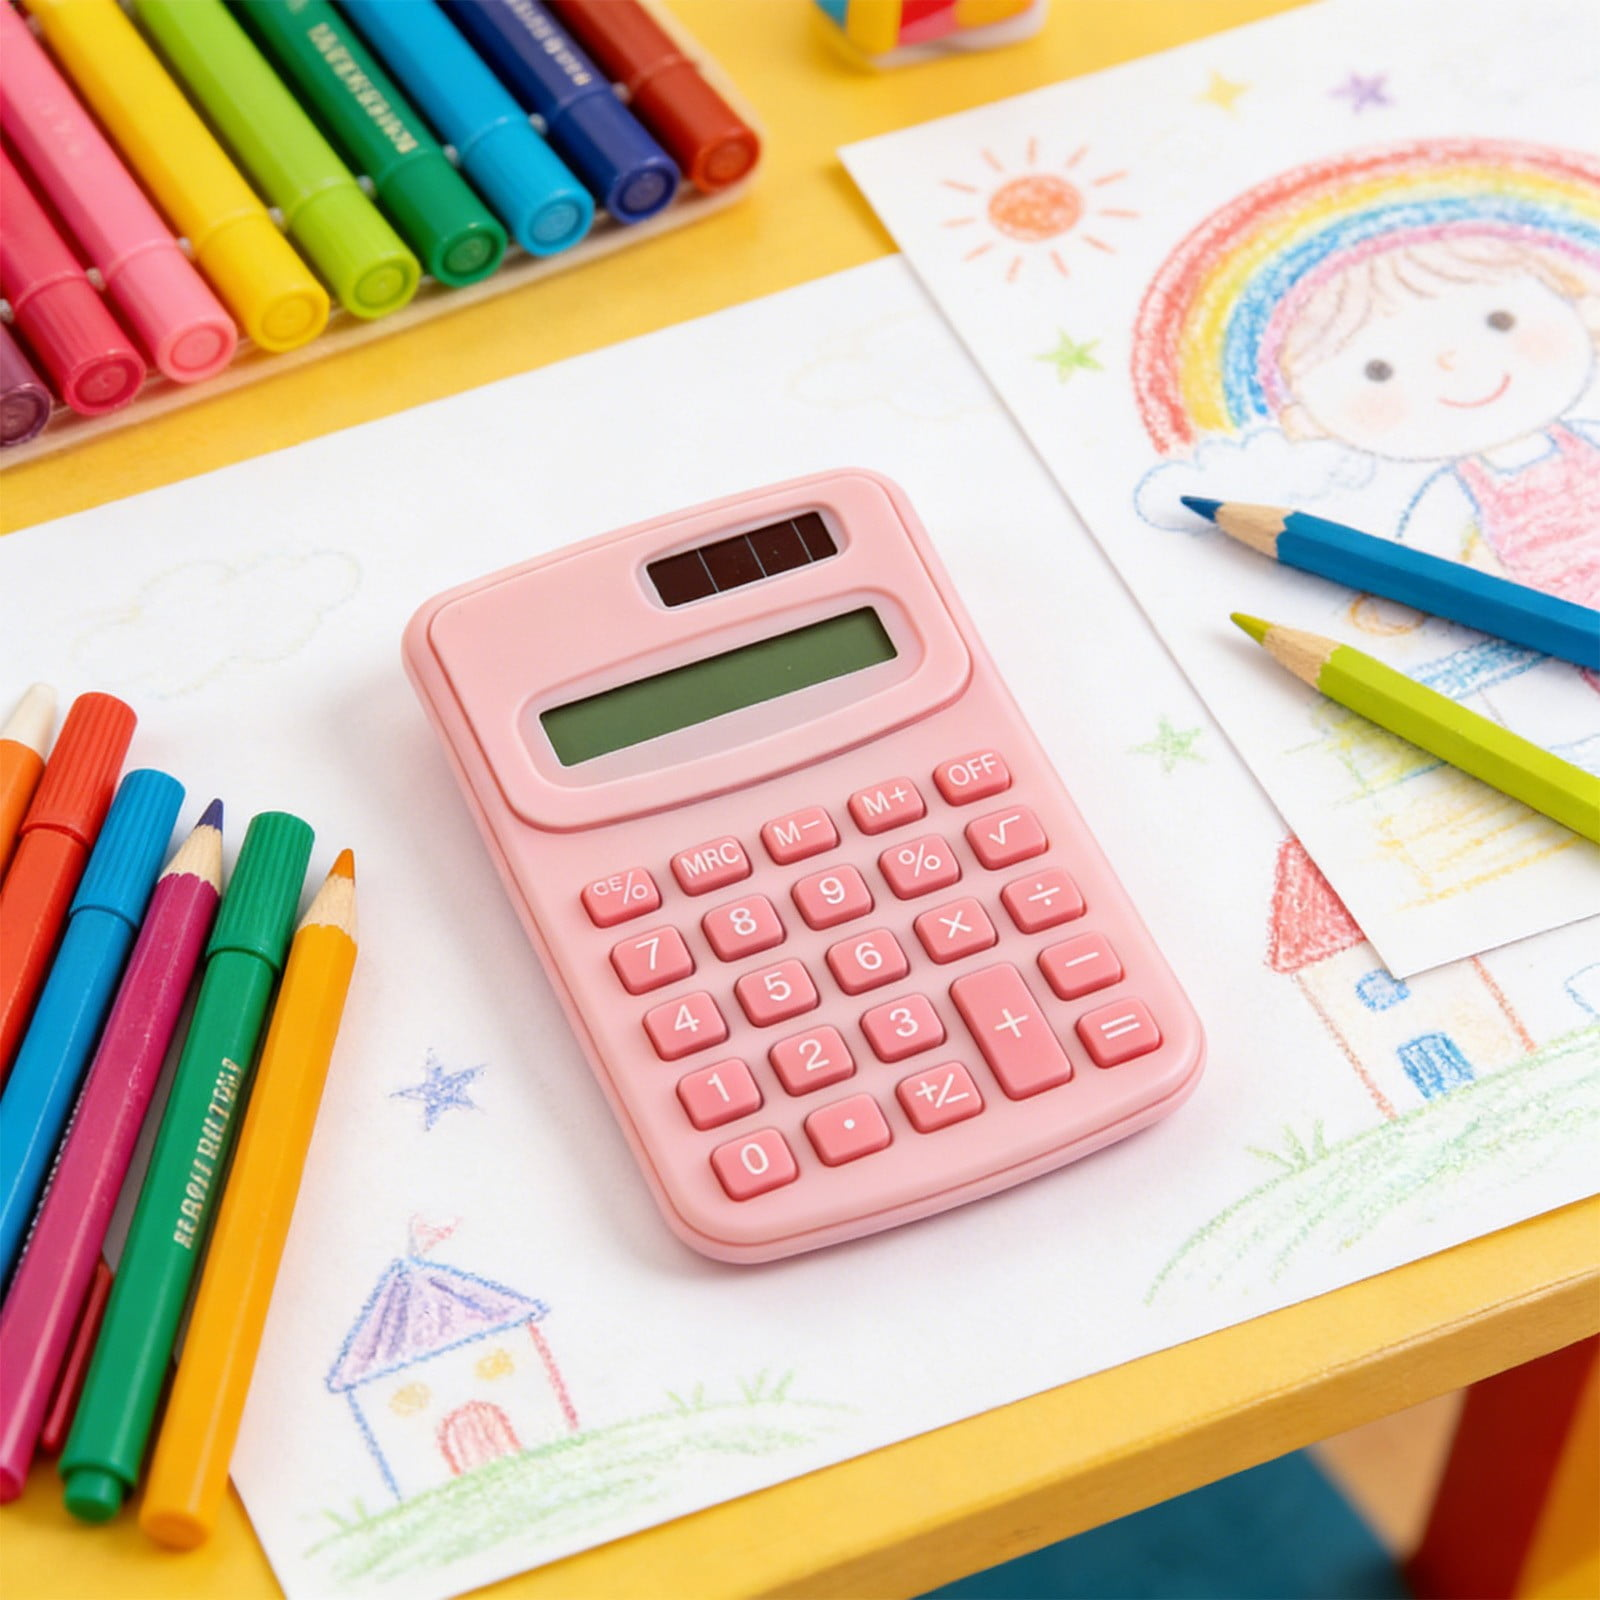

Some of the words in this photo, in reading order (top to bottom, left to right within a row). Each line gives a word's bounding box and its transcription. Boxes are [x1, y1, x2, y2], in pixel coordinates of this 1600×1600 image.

[949, 755, 996, 785] OFF
[862, 787, 906, 815] M+
[682, 843, 739, 876] MRC
[899, 844, 941, 876] %
[820, 877, 844, 904] 9
[730, 908, 756, 935] 8
[636, 937, 659, 969] 7
[855, 942, 882, 969] 6
[765, 972, 791, 1000] 5
[675, 1005, 699, 1031] 4
[890, 1008, 918, 1036] 3
[996, 1009, 1028, 1037] +
[1101, 1014, 1140, 1038] =
[799, 1039, 829, 1070] 2
[708, 1073, 729, 1101] 1
[741, 1144, 768, 1174] 0
